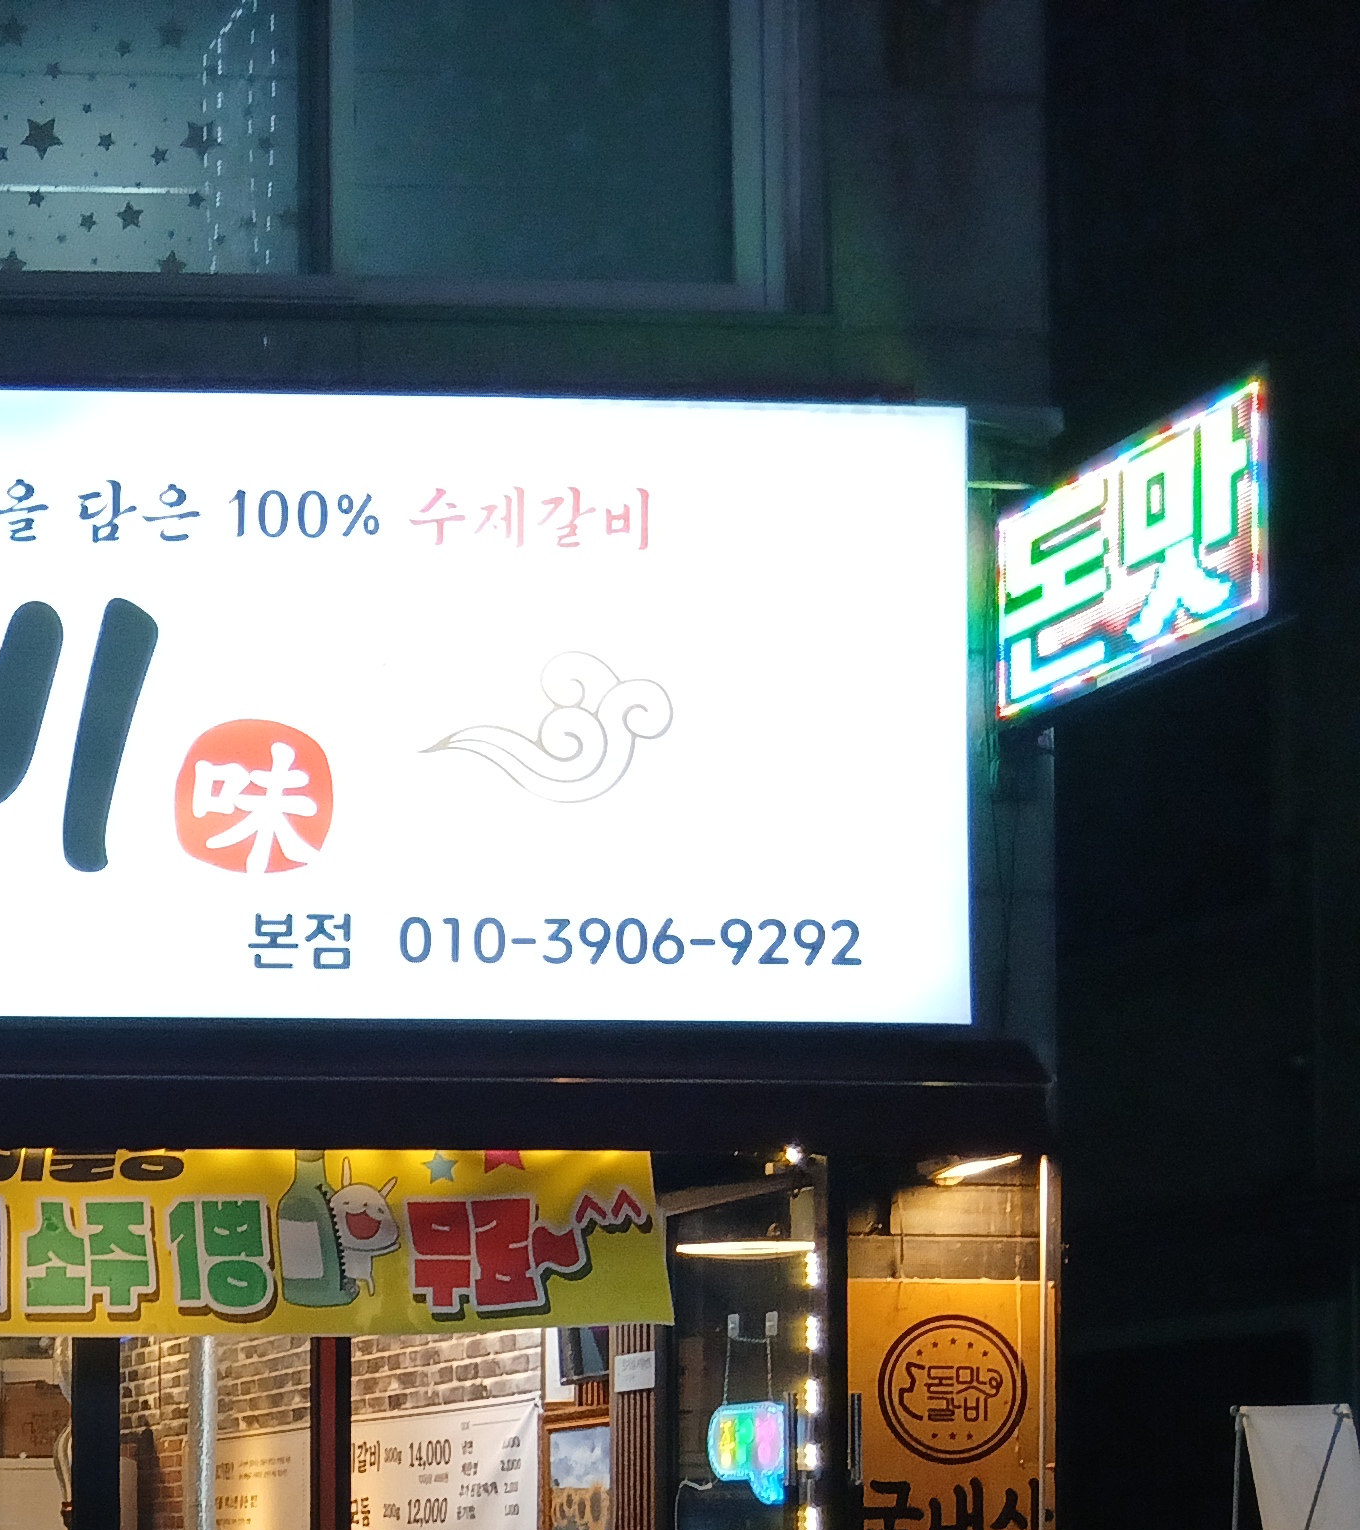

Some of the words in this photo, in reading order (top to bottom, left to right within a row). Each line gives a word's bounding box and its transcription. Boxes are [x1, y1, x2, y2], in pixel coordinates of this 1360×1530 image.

[78, 479, 201, 542] 담은
[228, 489, 380, 539] 100%
[409, 487, 651, 548] 수제갈비
[1004, 405, 1248, 701] 돈맛
[191, 742, 322, 873] 味
[248, 913, 352, 969] 본점
[399, 916, 862, 966] 010-3906-9292
[23, 1198, 156, 1314] 소주
[166, 1198, 276, 1316] 1병
[924, 1365, 996, 1398] 돈맛
[927, 1397, 990, 1422] 갈비
[408, 1438, 452, 1471] 14,000
[407, 1497, 448, 1528] 12,000
